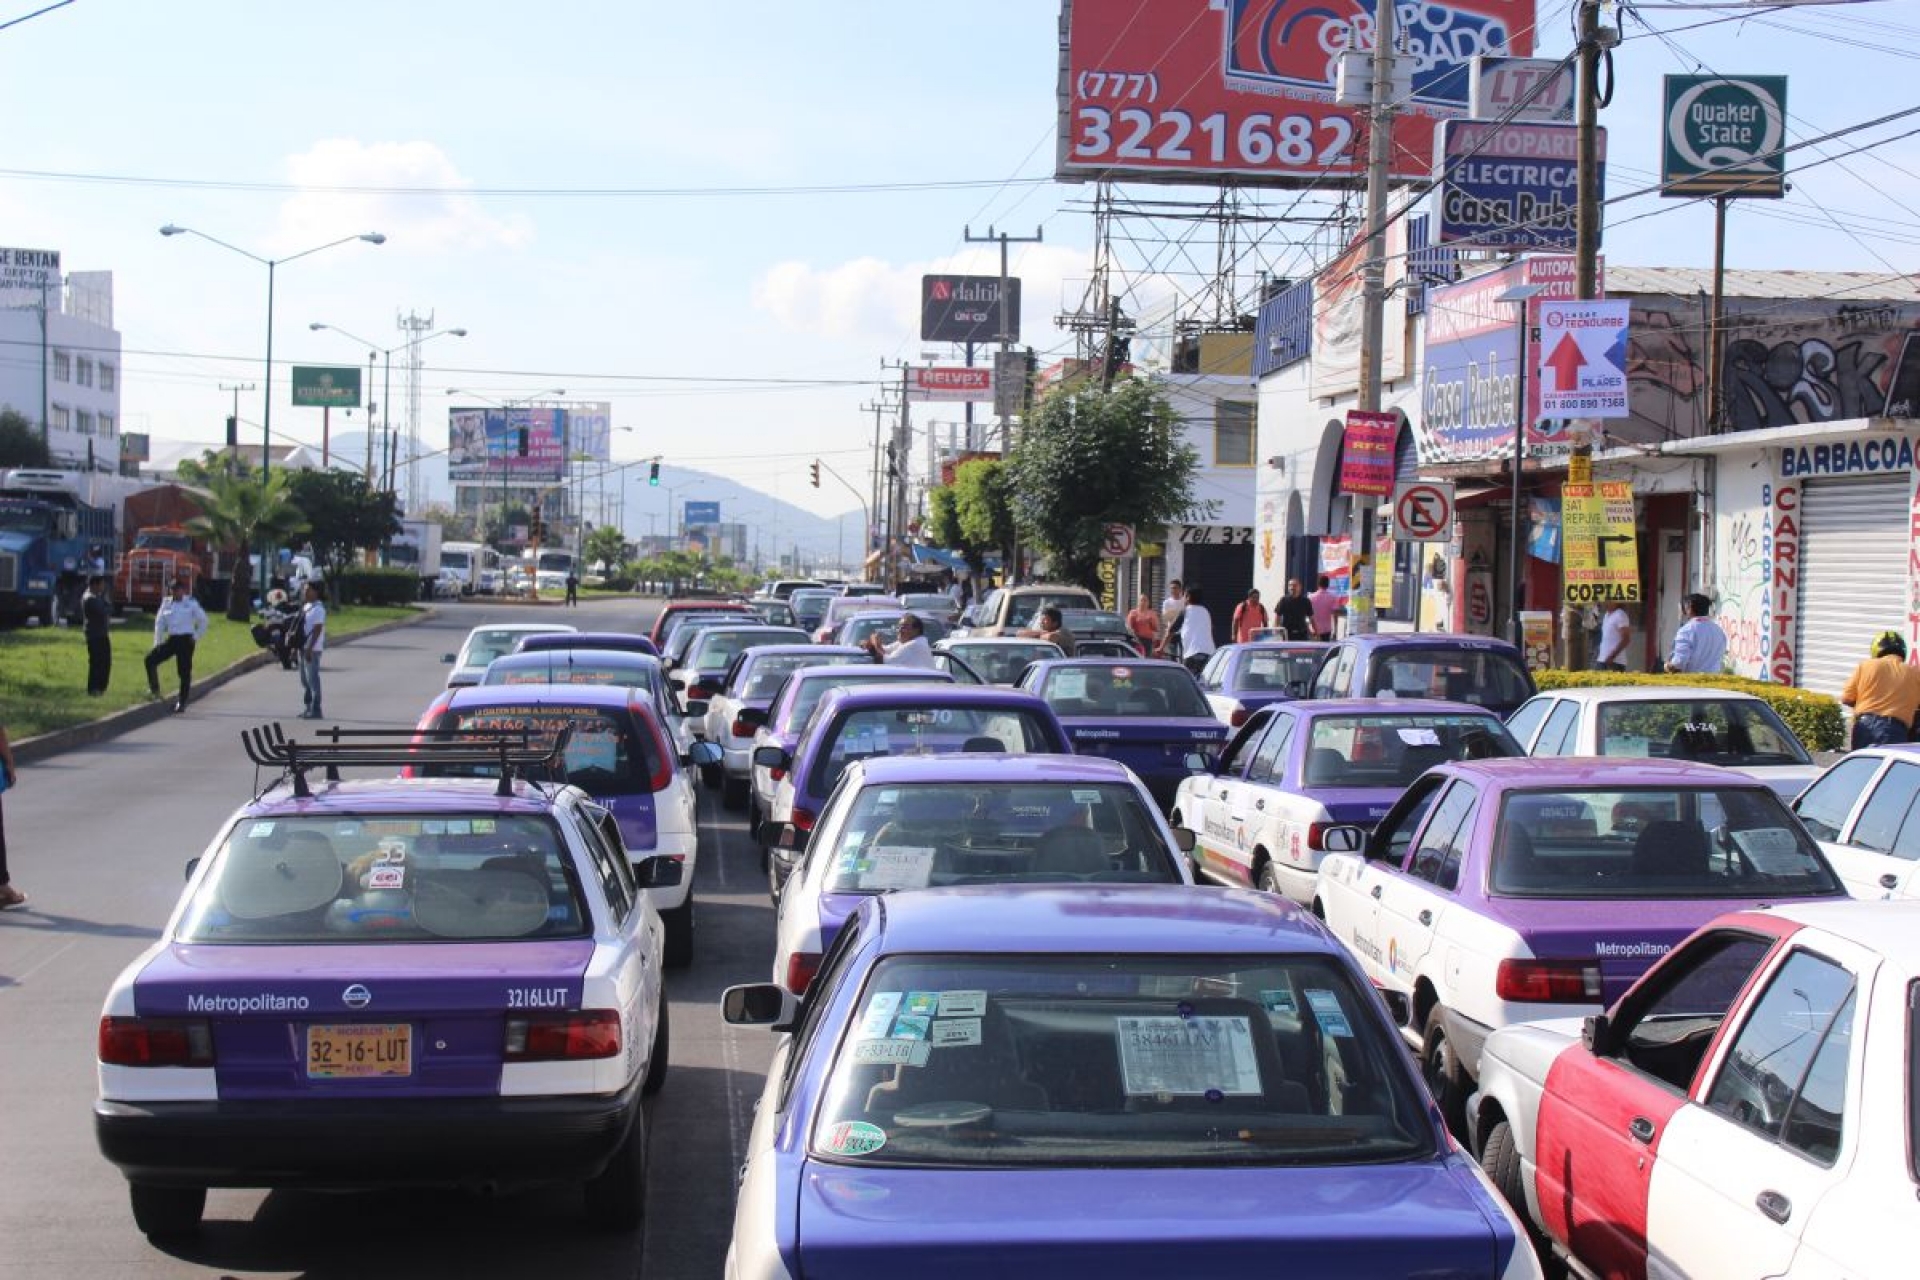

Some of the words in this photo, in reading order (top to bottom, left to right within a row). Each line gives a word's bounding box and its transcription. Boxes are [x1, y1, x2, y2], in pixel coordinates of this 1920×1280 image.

[1317, 0, 1454, 51] GRPO
[1077, 71, 1159, 103] (777)
[1692, 102, 1758, 127] Quaker
[1075, 106, 1355, 166] 3221682
[1460, 127, 1603, 157] AUTOPART
[1699, 125, 1751, 144] State
[1453, 163, 1600, 188] ELECTRICA
[1443, 187, 1512, 226] Casa
[14, 249, 60, 269] RENTAN
[1530, 258, 1602, 277] AUTOPAS
[1544, 400, 1557, 409] 01
[1780, 437, 1913, 476] BARBACOA
[1566, 583, 1638, 601] COPIAS
[1771, 486, 1798, 688] CARNITAS
[1596, 942, 1672, 958] Metropolitano
[187, 993, 310, 1014] Metropolitano
[507, 988, 570, 1008] 3216LUT
[311, 1039, 408, 1063] 32-16-LUT
